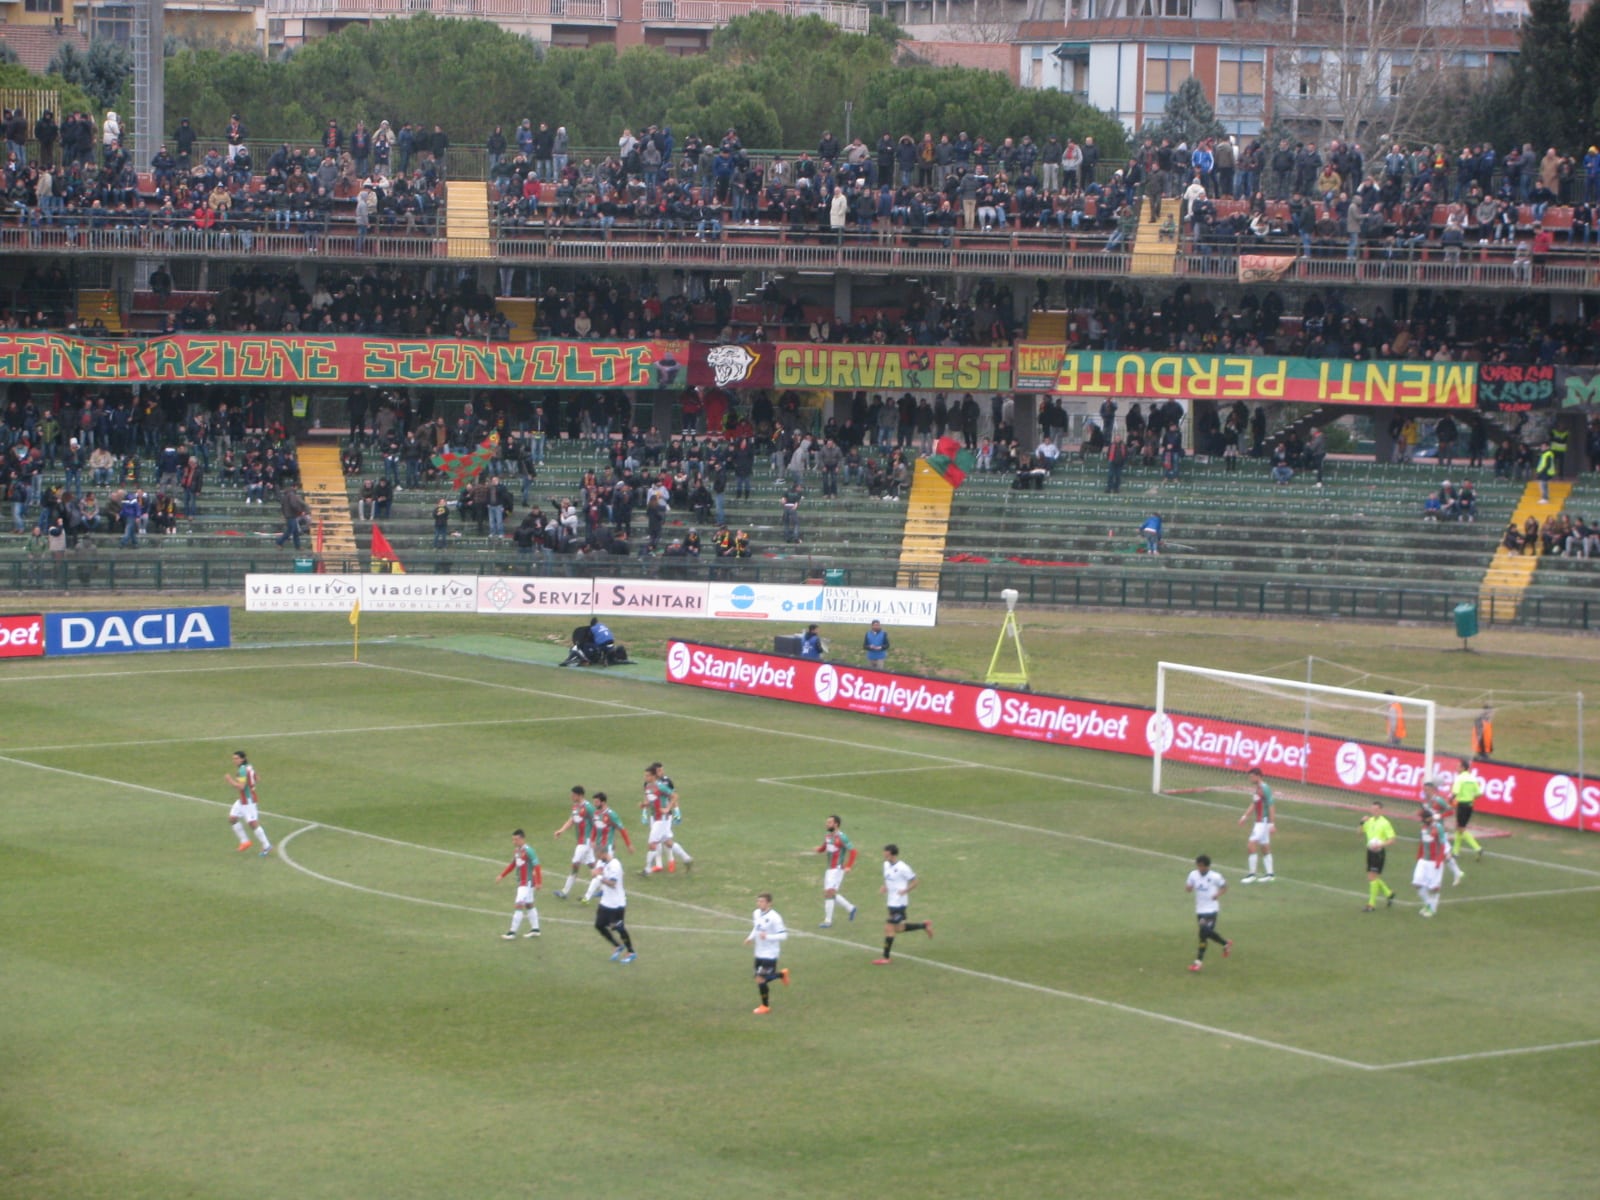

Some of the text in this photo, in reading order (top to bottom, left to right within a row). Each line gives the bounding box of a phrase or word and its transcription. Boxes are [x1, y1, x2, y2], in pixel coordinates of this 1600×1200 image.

[778, 349, 1007, 389] CURVA EST
[1318, 362, 1473, 404] MENTI
[252, 584, 357, 596] viadelrivo
[369, 585, 473, 597] viadelrivo
[825, 588, 860, 599] BANCA
[825, 598, 933, 616] MEDIOLANUM
[61, 612, 215, 649] DACIA
[691, 651, 796, 689] Stanleybet
[839, 673, 955, 714] Stanleybet
[1002, 698, 1129, 739] Stanleybet
[1175, 721, 1311, 768] Stanleybet
